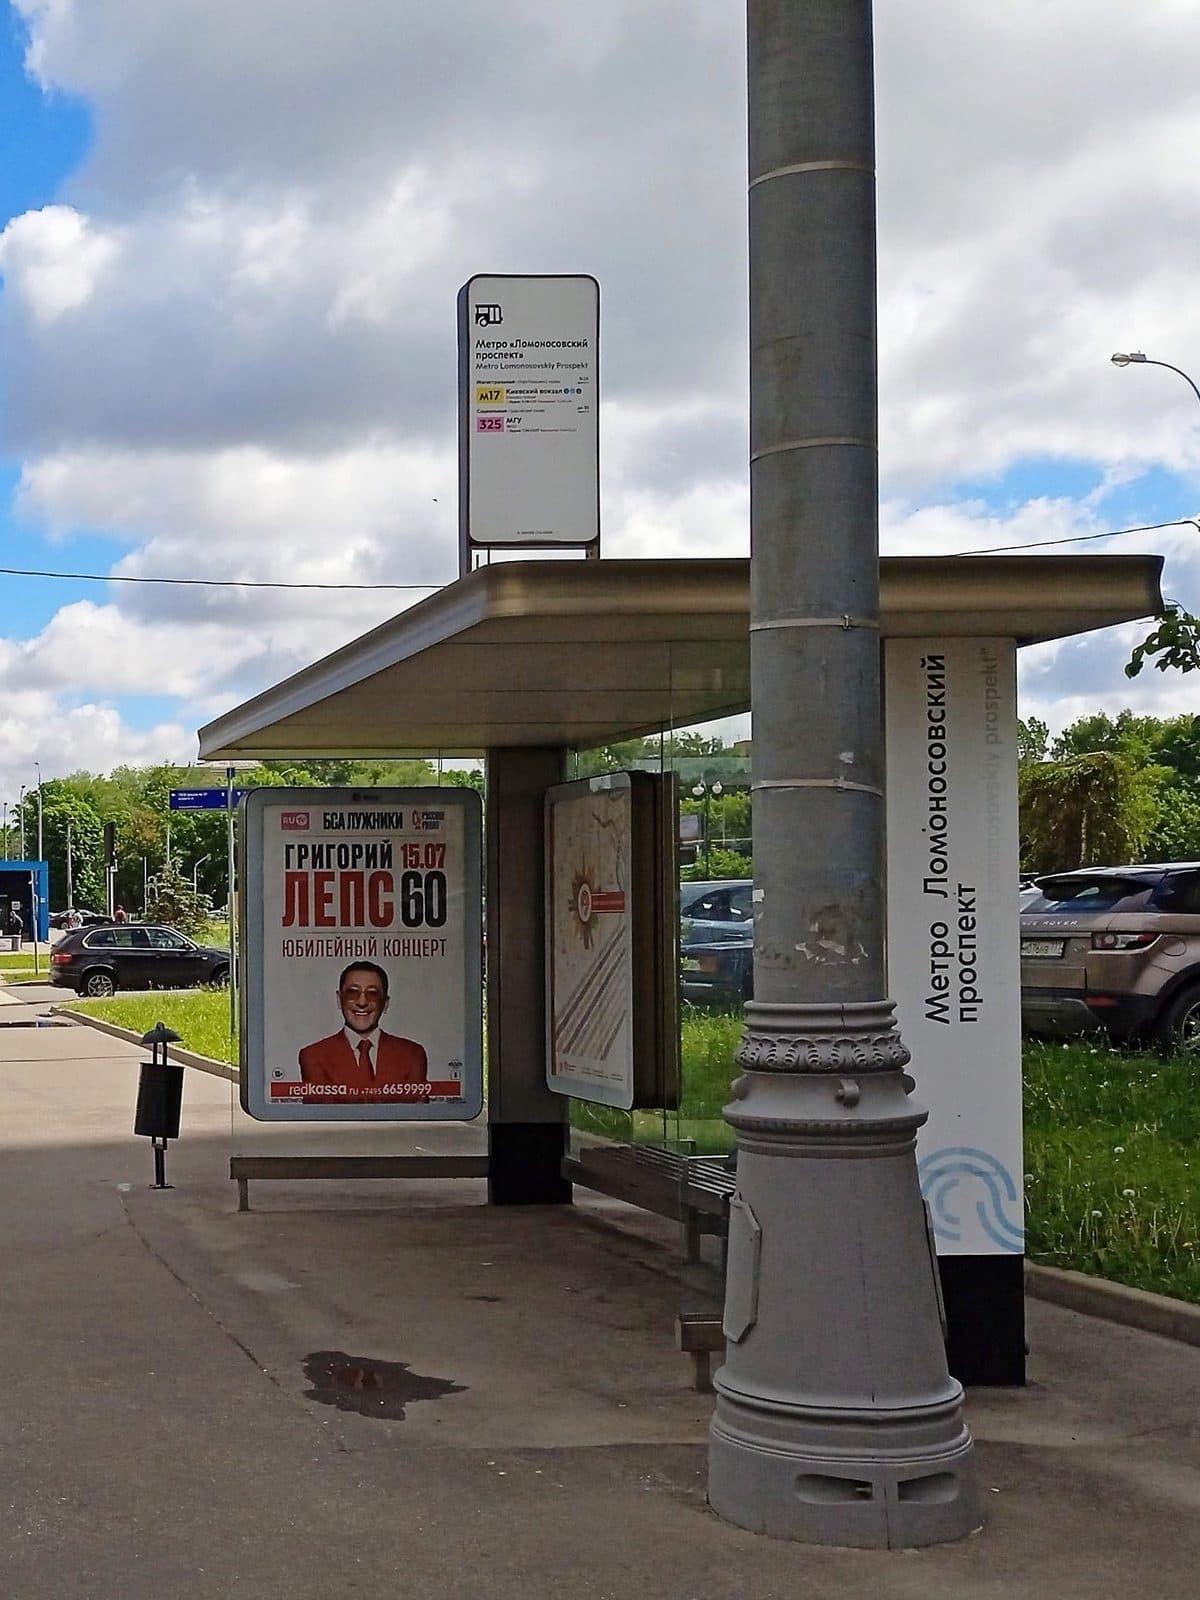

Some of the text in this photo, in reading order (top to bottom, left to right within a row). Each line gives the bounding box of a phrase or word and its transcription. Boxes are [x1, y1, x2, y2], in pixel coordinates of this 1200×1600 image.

[475, 338, 588, 350] Метро «Ломоносовский
[475, 351, 524, 361] проспект»
[556, 362, 588, 370] Prospekt
[479, 419, 502, 430] 325
[323, 812, 346, 830] БСА
[347, 812, 403, 830] ЛУЖНИКИ
[920, 654, 955, 1024] Метро Ломоносовский
[285, 839, 393, 869] ГРИГОРИЙ
[400, 843, 447, 869] 15.07
[282, 871, 394, 928] ЛЕПС
[401, 870, 447, 928] 60
[282, 935, 447, 958] ЮБИЛЕЙНЫЙ КОНЦЕРТ
[956, 883, 983, 1023] проспект
[289, 1083, 347, 1096] redkassa
[383, 1083, 432, 1095] 6659999
